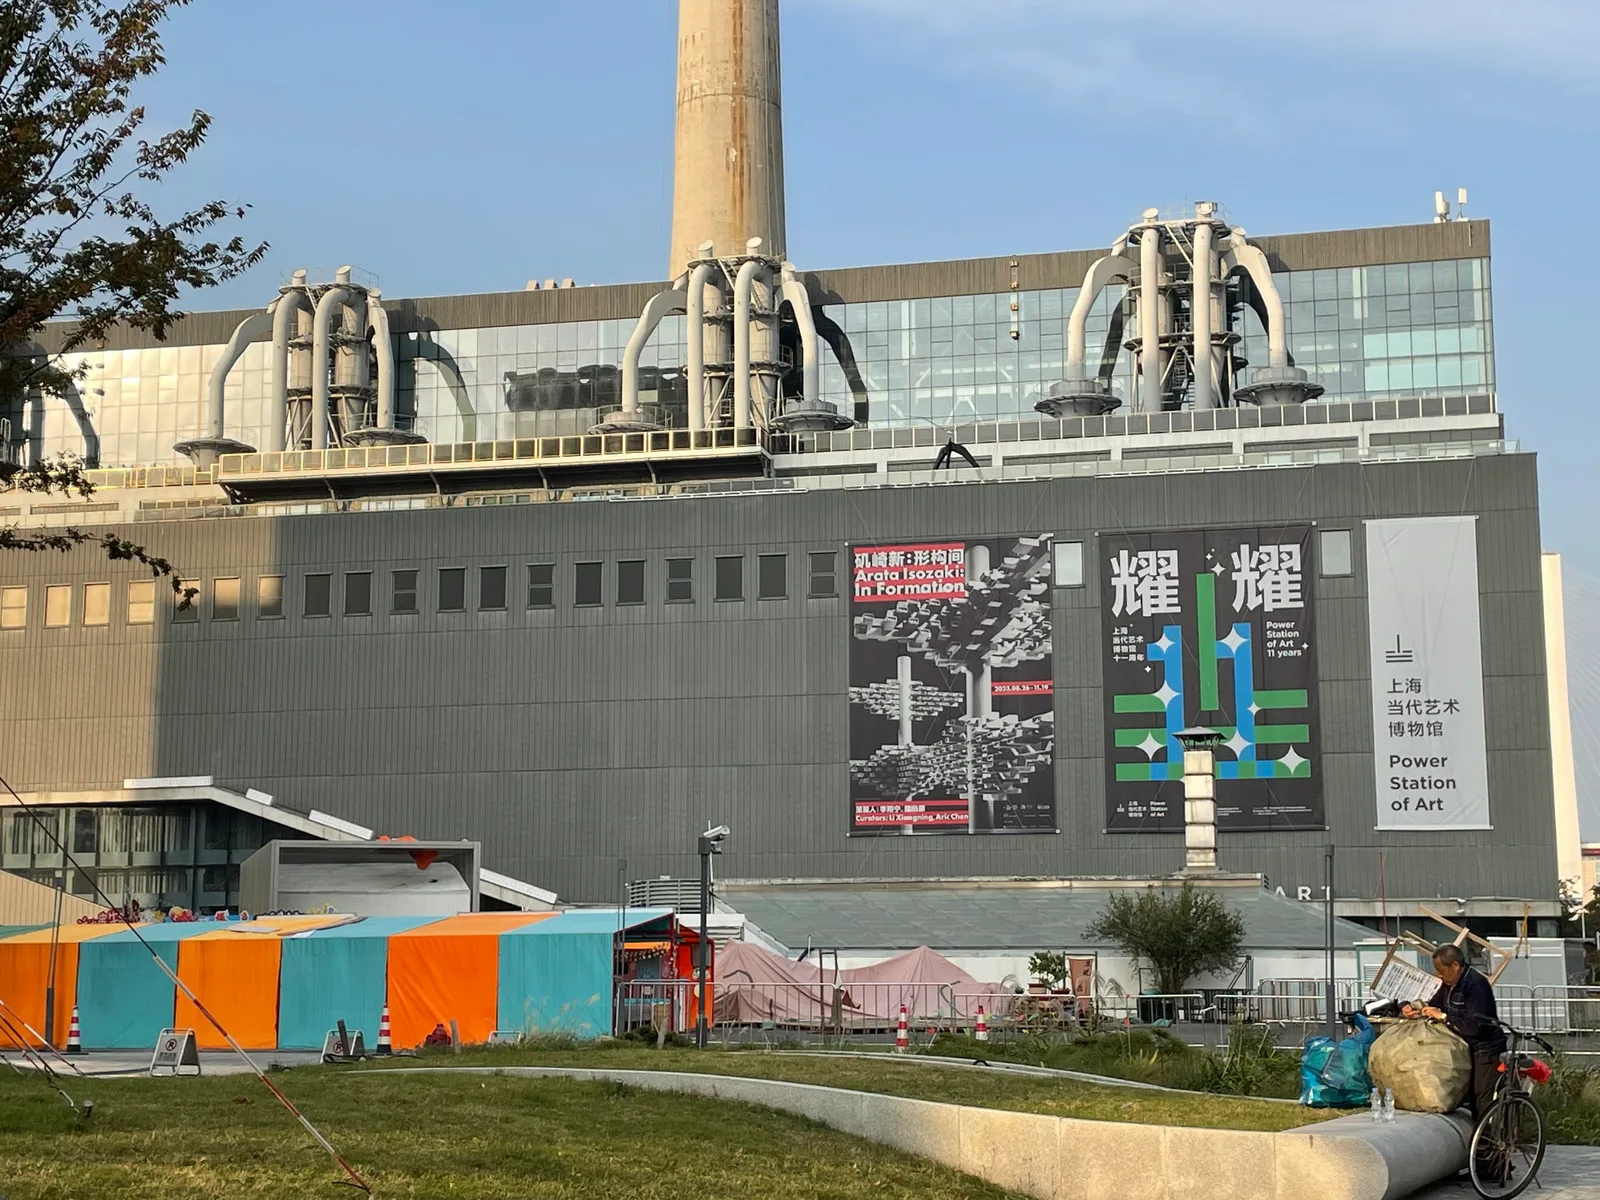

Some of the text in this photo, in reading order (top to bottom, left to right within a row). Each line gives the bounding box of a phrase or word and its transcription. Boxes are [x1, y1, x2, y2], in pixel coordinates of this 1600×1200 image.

[855, 564, 965, 582] Arata Isozaki:
[1110, 543, 1305, 618] 耀 耀
[854, 578, 965, 597] In Formation
[1266, 621, 1296, 629] Power
[1266, 629, 1300, 639] Station
[1266, 639, 1294, 648] of Art
[1266, 649, 1302, 659] 11 years
[1387, 677, 1422, 694] 上海
[1387, 698, 1460, 716] 当代艺术
[1388, 720, 1443, 738] 博物馆
[1389, 754, 1448, 768] Power
[1390, 775, 1456, 790] Station
[1391, 796, 1444, 811] of Art
[1275, 885, 1331, 901] ART
